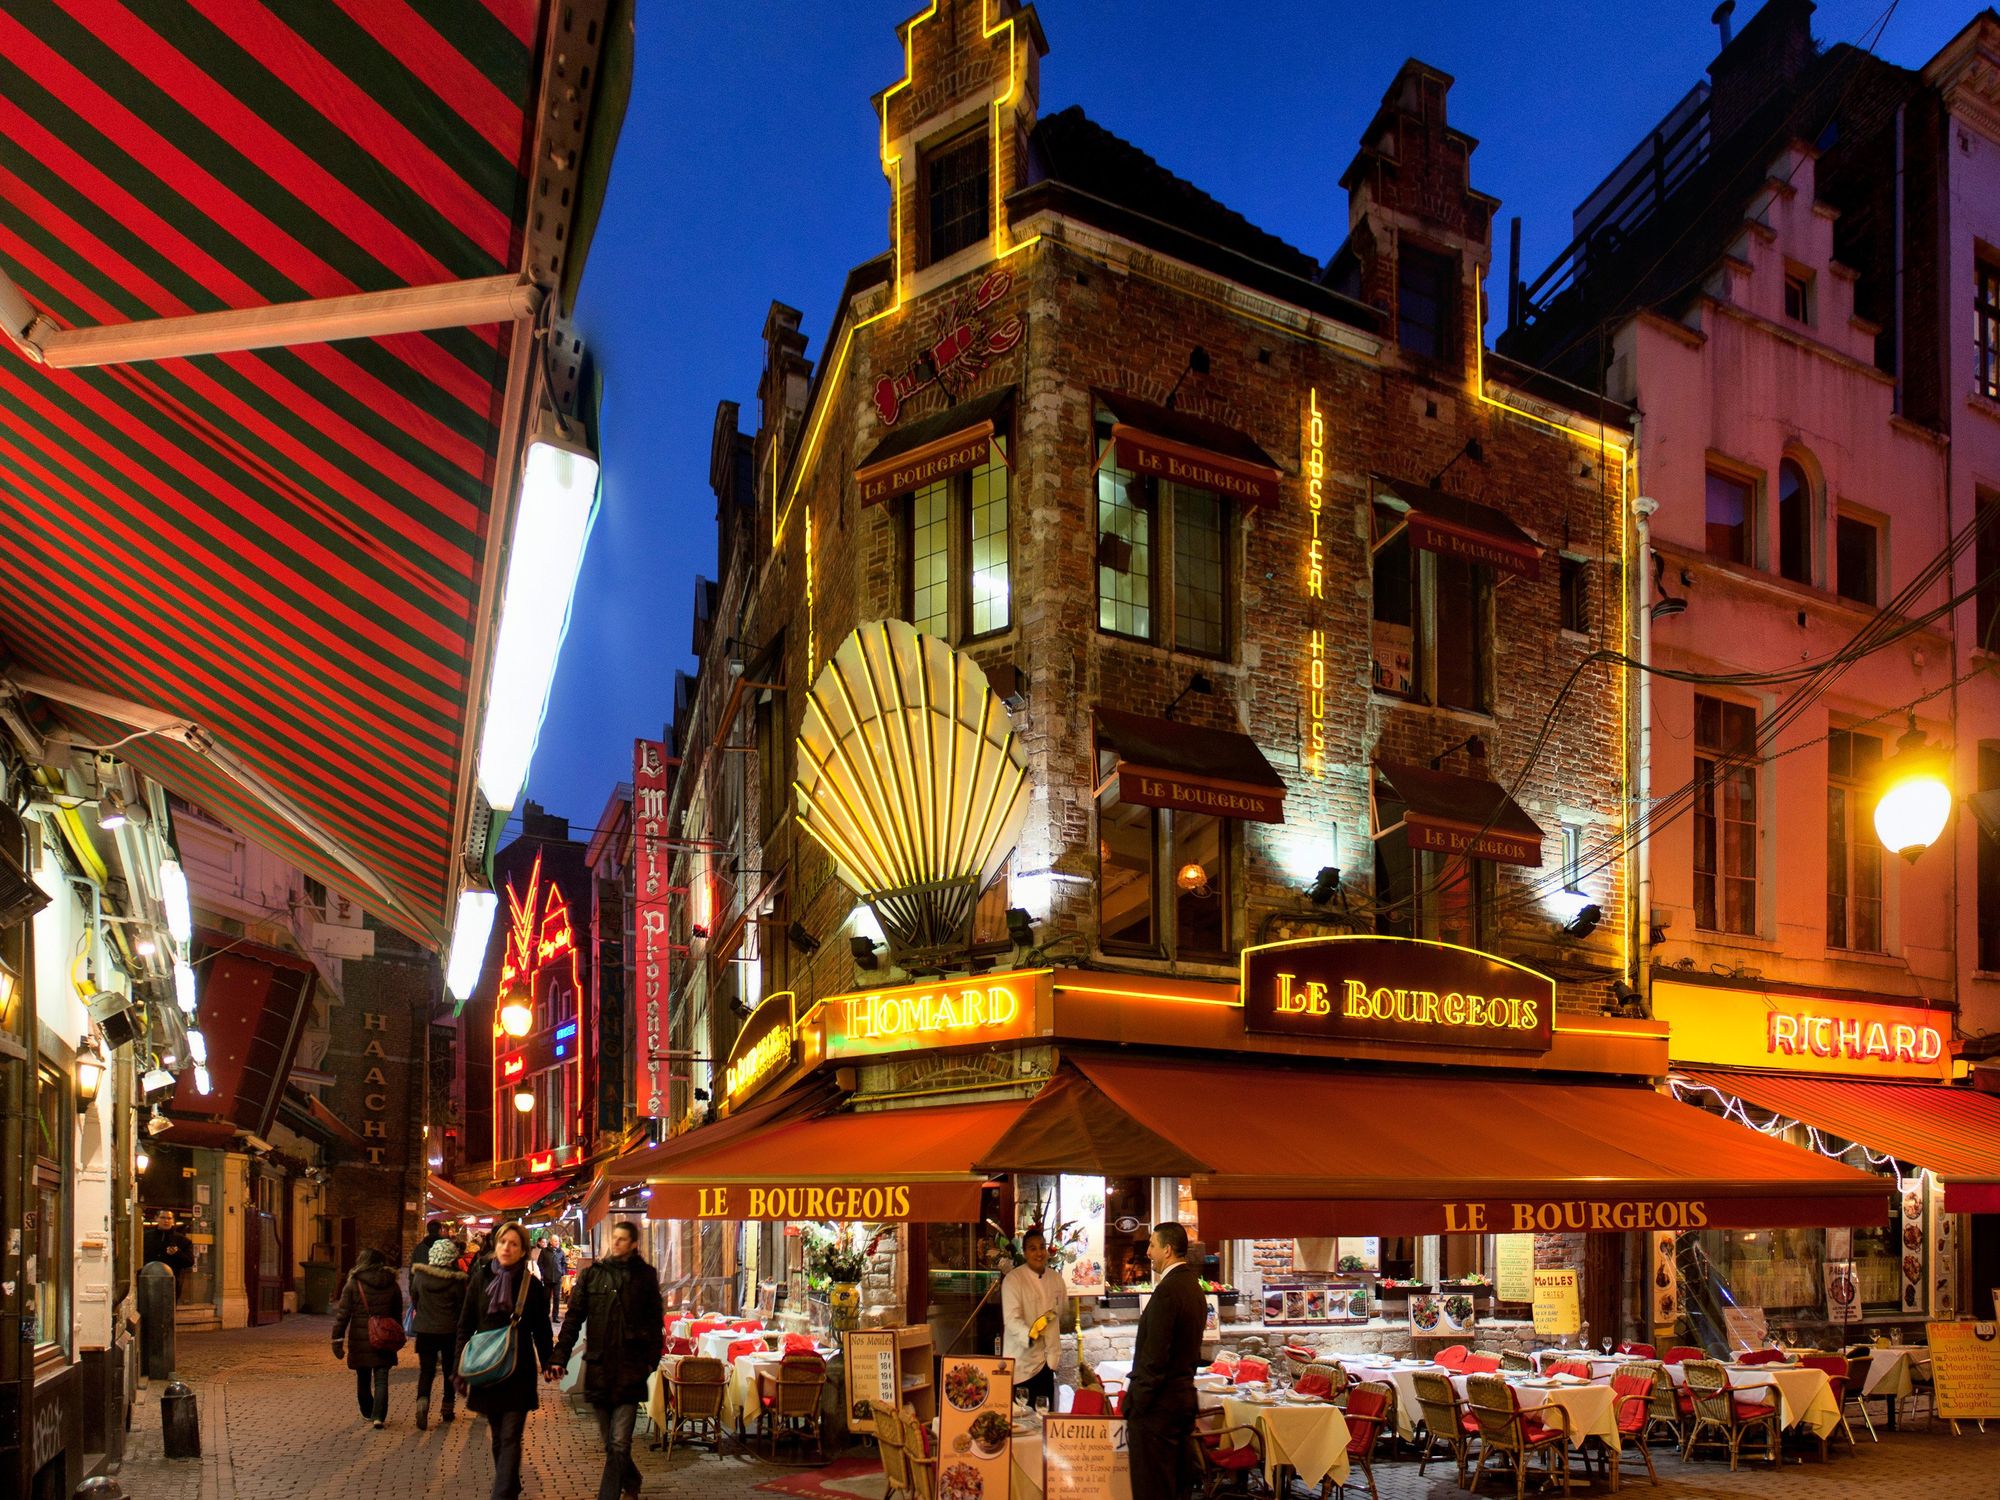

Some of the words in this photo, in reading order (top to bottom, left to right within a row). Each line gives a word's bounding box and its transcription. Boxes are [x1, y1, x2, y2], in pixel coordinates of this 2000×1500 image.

[864, 480, 887, 500] LE
[892, 443, 986, 490] BOURGEOIS
[1138, 449, 1162, 470] LE
[1168, 456, 1261, 497] BOURGEOIS
[1307, 387, 1324, 600] LOBSTER
[1426, 529, 1447, 547] LE
[1452, 536, 1527, 571] BOURGEOIS
[1310, 630, 1325, 780] HOUSE
[1140, 778, 1166, 798] LE
[1172, 783, 1265, 813] BOURGEOIS
[1425, 828, 1446, 846] LE
[843, 987, 1016, 1039] HOMARD
[1276, 973, 1331, 1015] LE
[1344, 979, 1538, 1030] BOURGEOIS
[1768, 1012, 1942, 1064] RICHARD
[363, 1012, 388, 1165] HAACHT
[697, 1187, 729, 1217] LE
[748, 1185, 910, 1219] BOURGEOIS
[1443, 1203, 1488, 1232] LE
[1511, 1201, 1708, 1231] BOURGEOIS
[867, 1334, 893, 1346] Moules
[1049, 1421, 1095, 1440] Menu
[1100, 1425, 1107, 1439] à
